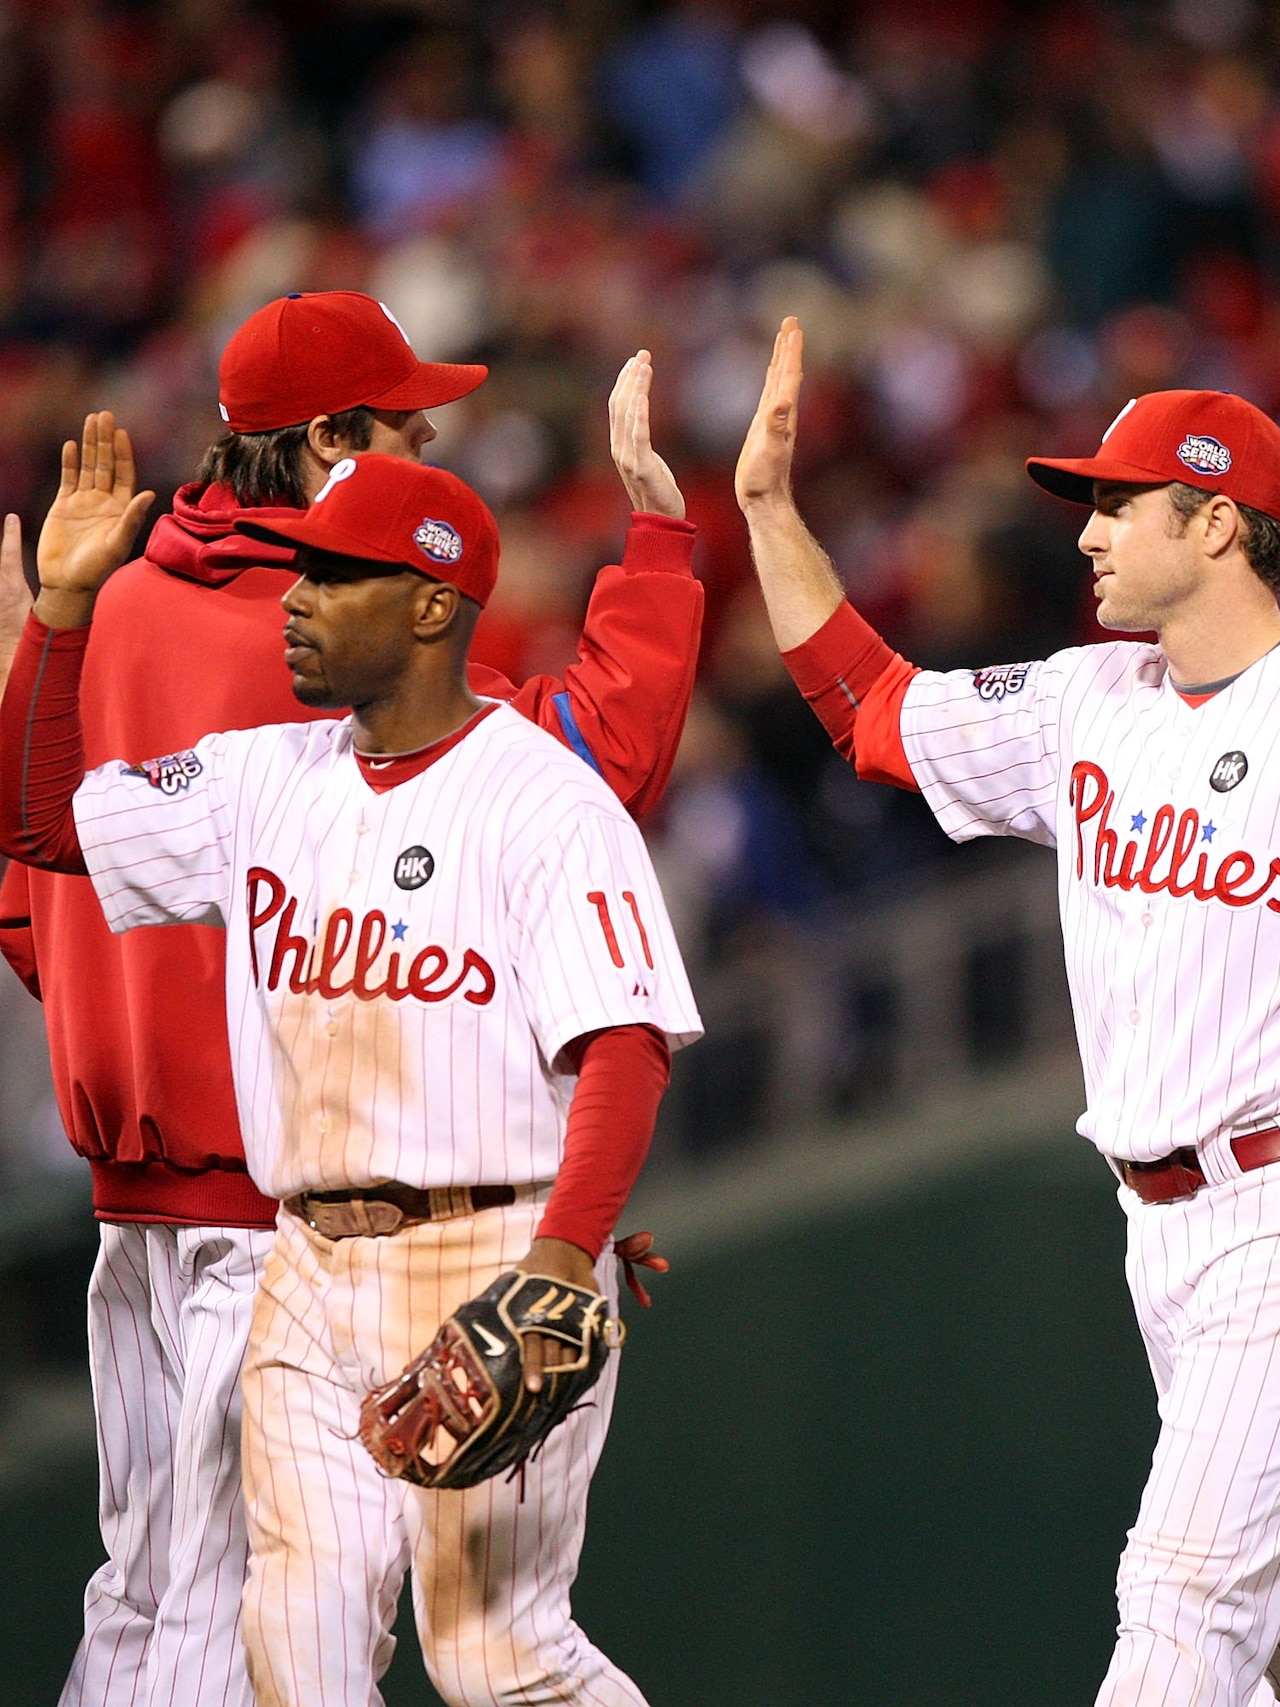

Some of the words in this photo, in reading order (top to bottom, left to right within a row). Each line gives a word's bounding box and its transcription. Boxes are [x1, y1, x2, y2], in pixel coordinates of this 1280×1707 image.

[1180, 444, 1228, 470] SERIES
[1190, 437, 1227, 457] WORLD
[415, 528, 462, 559] SERIES
[426, 522, 459, 545] WORLD
[1213, 761, 1244, 782] HK
[398, 856, 429, 879] HK
[246, 866, 496, 1006] Phillies
[586, 891, 654, 970] 11
